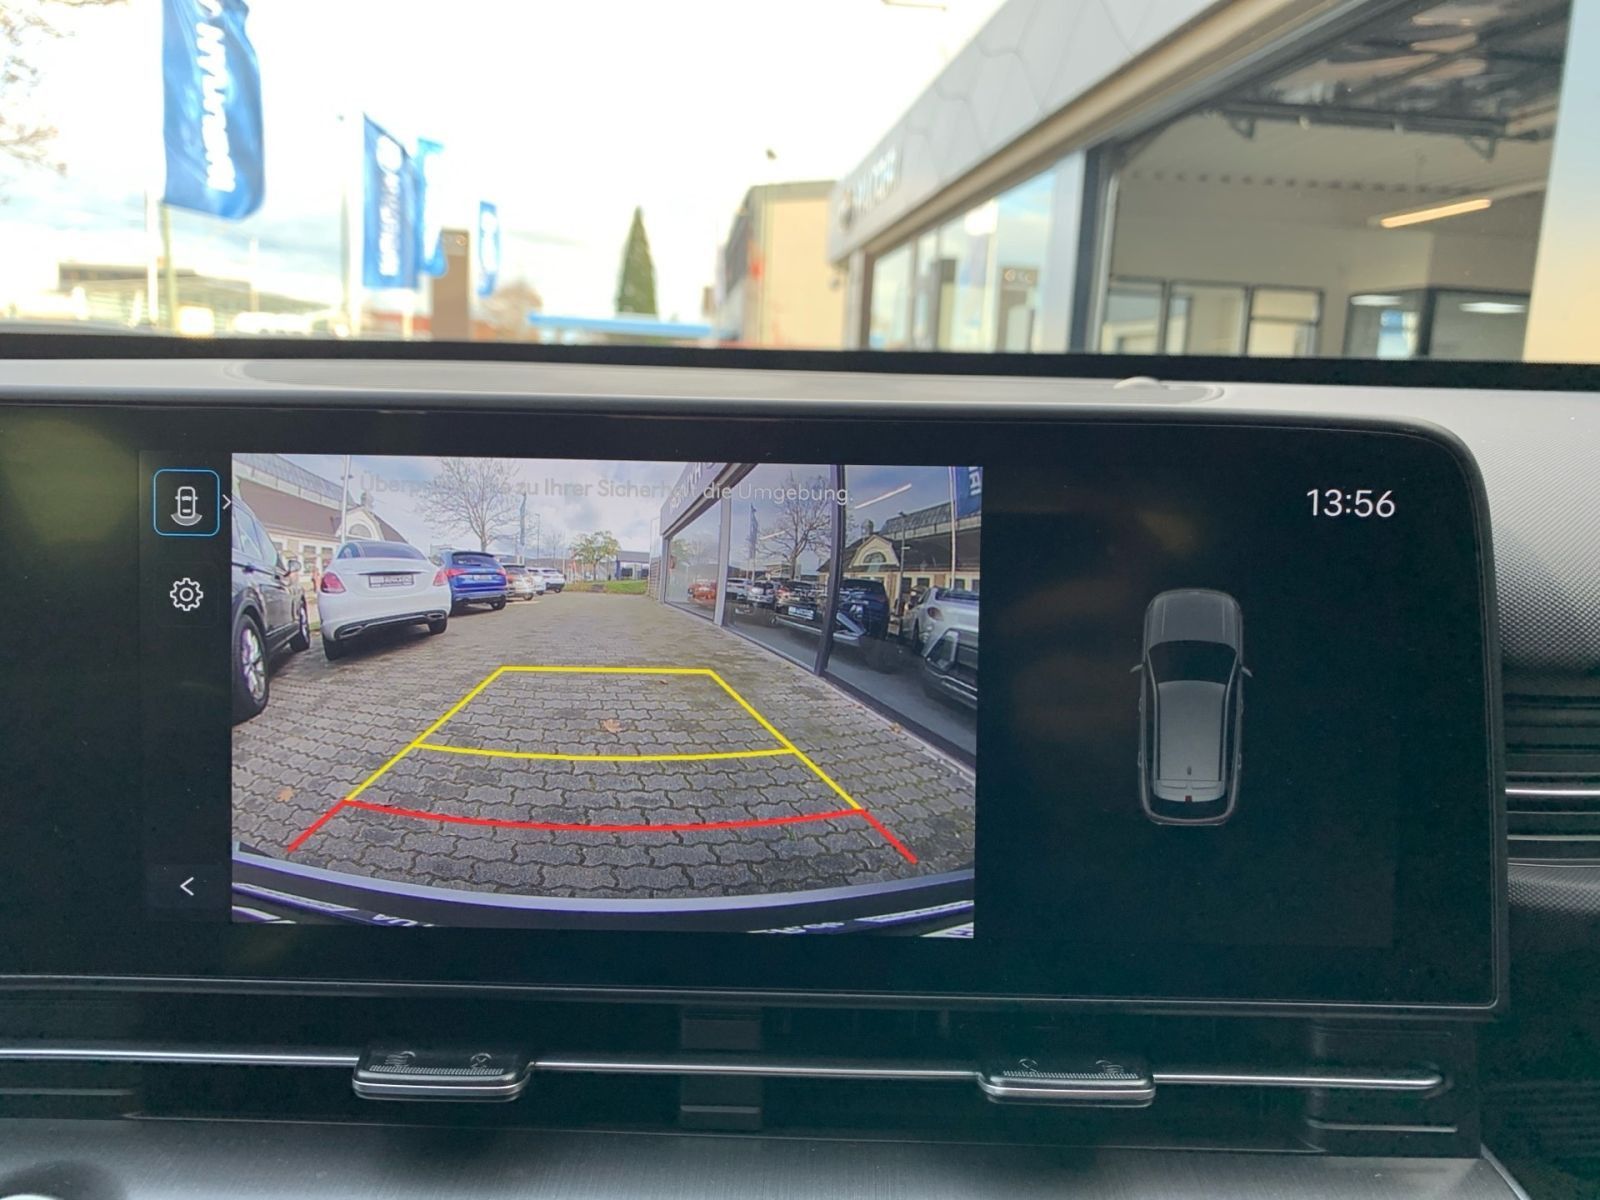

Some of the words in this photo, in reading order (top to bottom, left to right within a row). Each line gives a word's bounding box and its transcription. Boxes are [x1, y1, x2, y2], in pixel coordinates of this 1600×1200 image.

[544, 478, 593, 497] Ihrer
[703, 480, 732, 500] die
[738, 483, 854, 505] Umgebung.
[1306, 489, 1396, 518] 13:56
